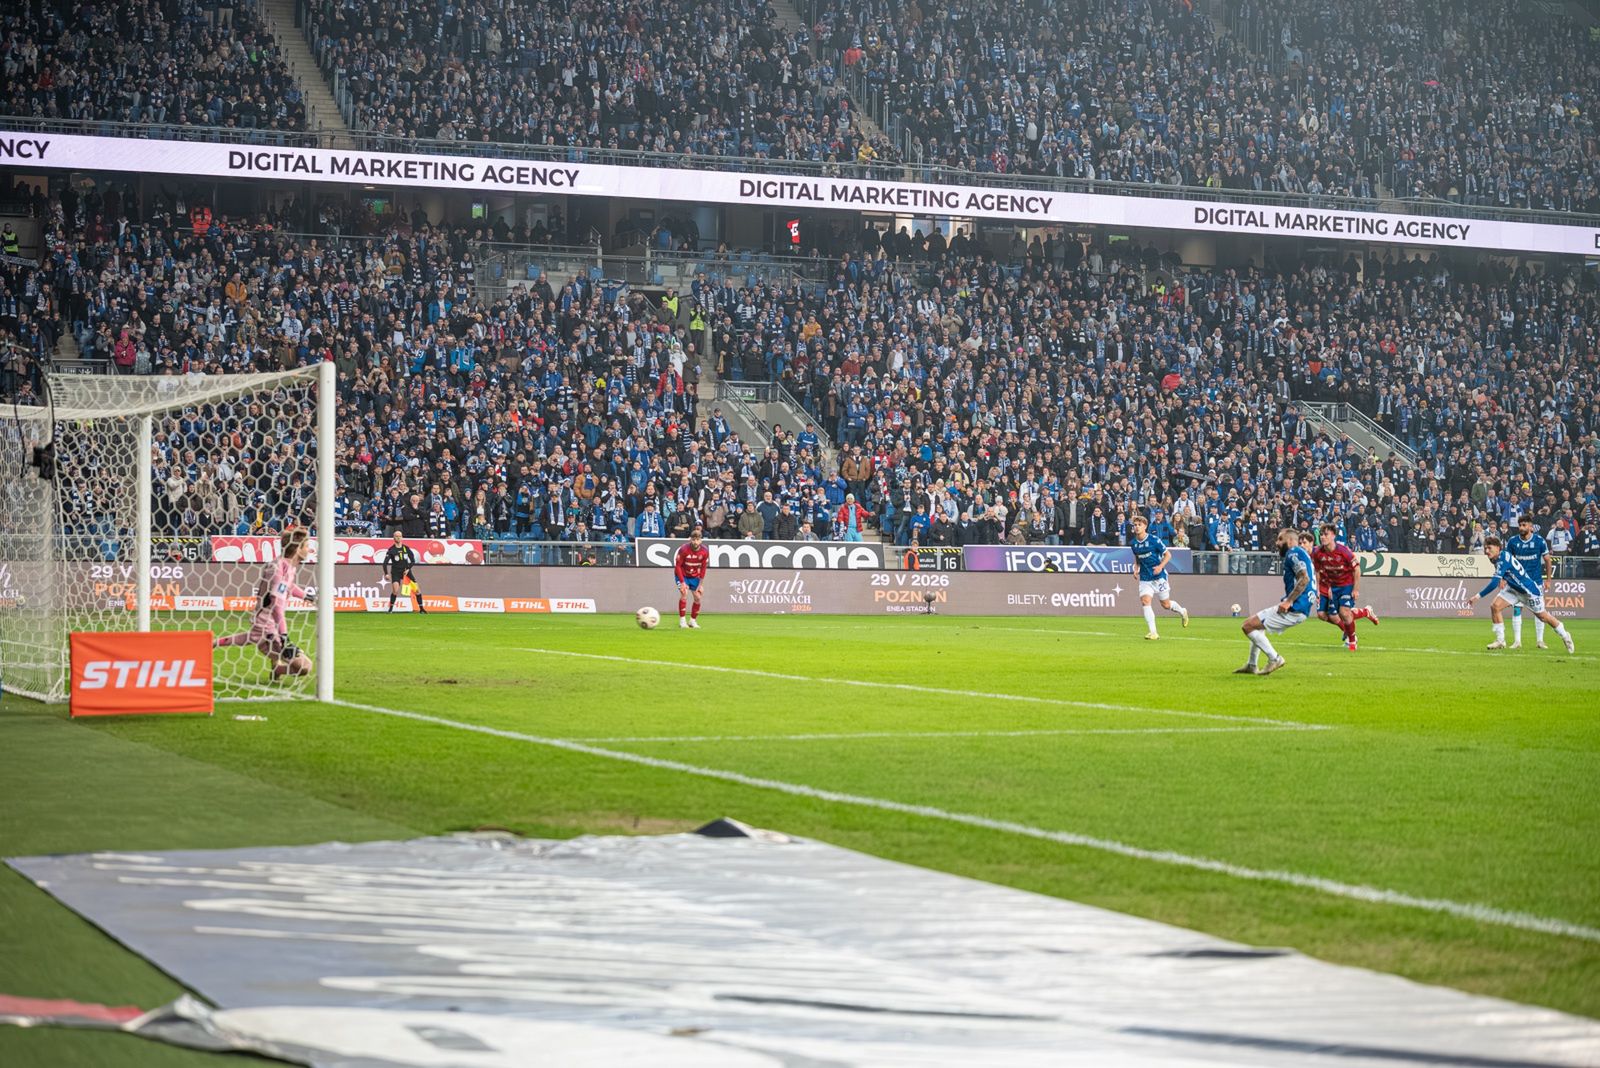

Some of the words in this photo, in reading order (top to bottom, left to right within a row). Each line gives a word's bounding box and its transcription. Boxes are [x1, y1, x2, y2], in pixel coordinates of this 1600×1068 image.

[228, 150, 323, 174] DIGITAL
[330, 156, 475, 182] MARKETING
[481, 165, 580, 188] AGENCY
[739, 179, 825, 201] DIGITAL
[831, 184, 959, 209] MARKETING
[965, 192, 1053, 214] AGENCY
[1194, 207, 1270, 228] DIGITAL
[1274, 212, 1388, 236] MARKETING
[1393, 220, 1471, 241] AGENCY
[183, 547, 197, 560] 15
[646, 543, 879, 569] smcore
[944, 557, 957, 569] 16
[1005, 551, 1097, 573] iFOREX
[91, 565, 114, 578] 29
[120, 565, 133, 578] V
[150, 565, 184, 579] 026
[736, 571, 805, 595] sanah
[871, 574, 890, 586] 29
[895, 574, 907, 586] V
[911, 574, 950, 587] 2026
[1554, 582, 1586, 593] 2026
[95, 581, 180, 597] POZAŃ
[304, 581, 379, 598] entim
[874, 588, 947, 603] POZNŃ
[1412, 580, 1468, 601] sanah
[181, 599, 217, 607] STIHL
[333, 600, 361, 608] TIHL
[464, 600, 498, 609] STIHL
[556, 601, 590, 609] STIHL
[730, 594, 744, 604] NA
[747, 594, 812, 605] STADIONACH
[1008, 594, 1048, 605] BILETY:
[1051, 588, 1115, 608] eventim
[1406, 601, 1418, 609] NA
[1544, 594, 1585, 608] ZNAŃ
[510, 601, 546, 610] STIHL
[79, 660, 207, 689] STIHL
